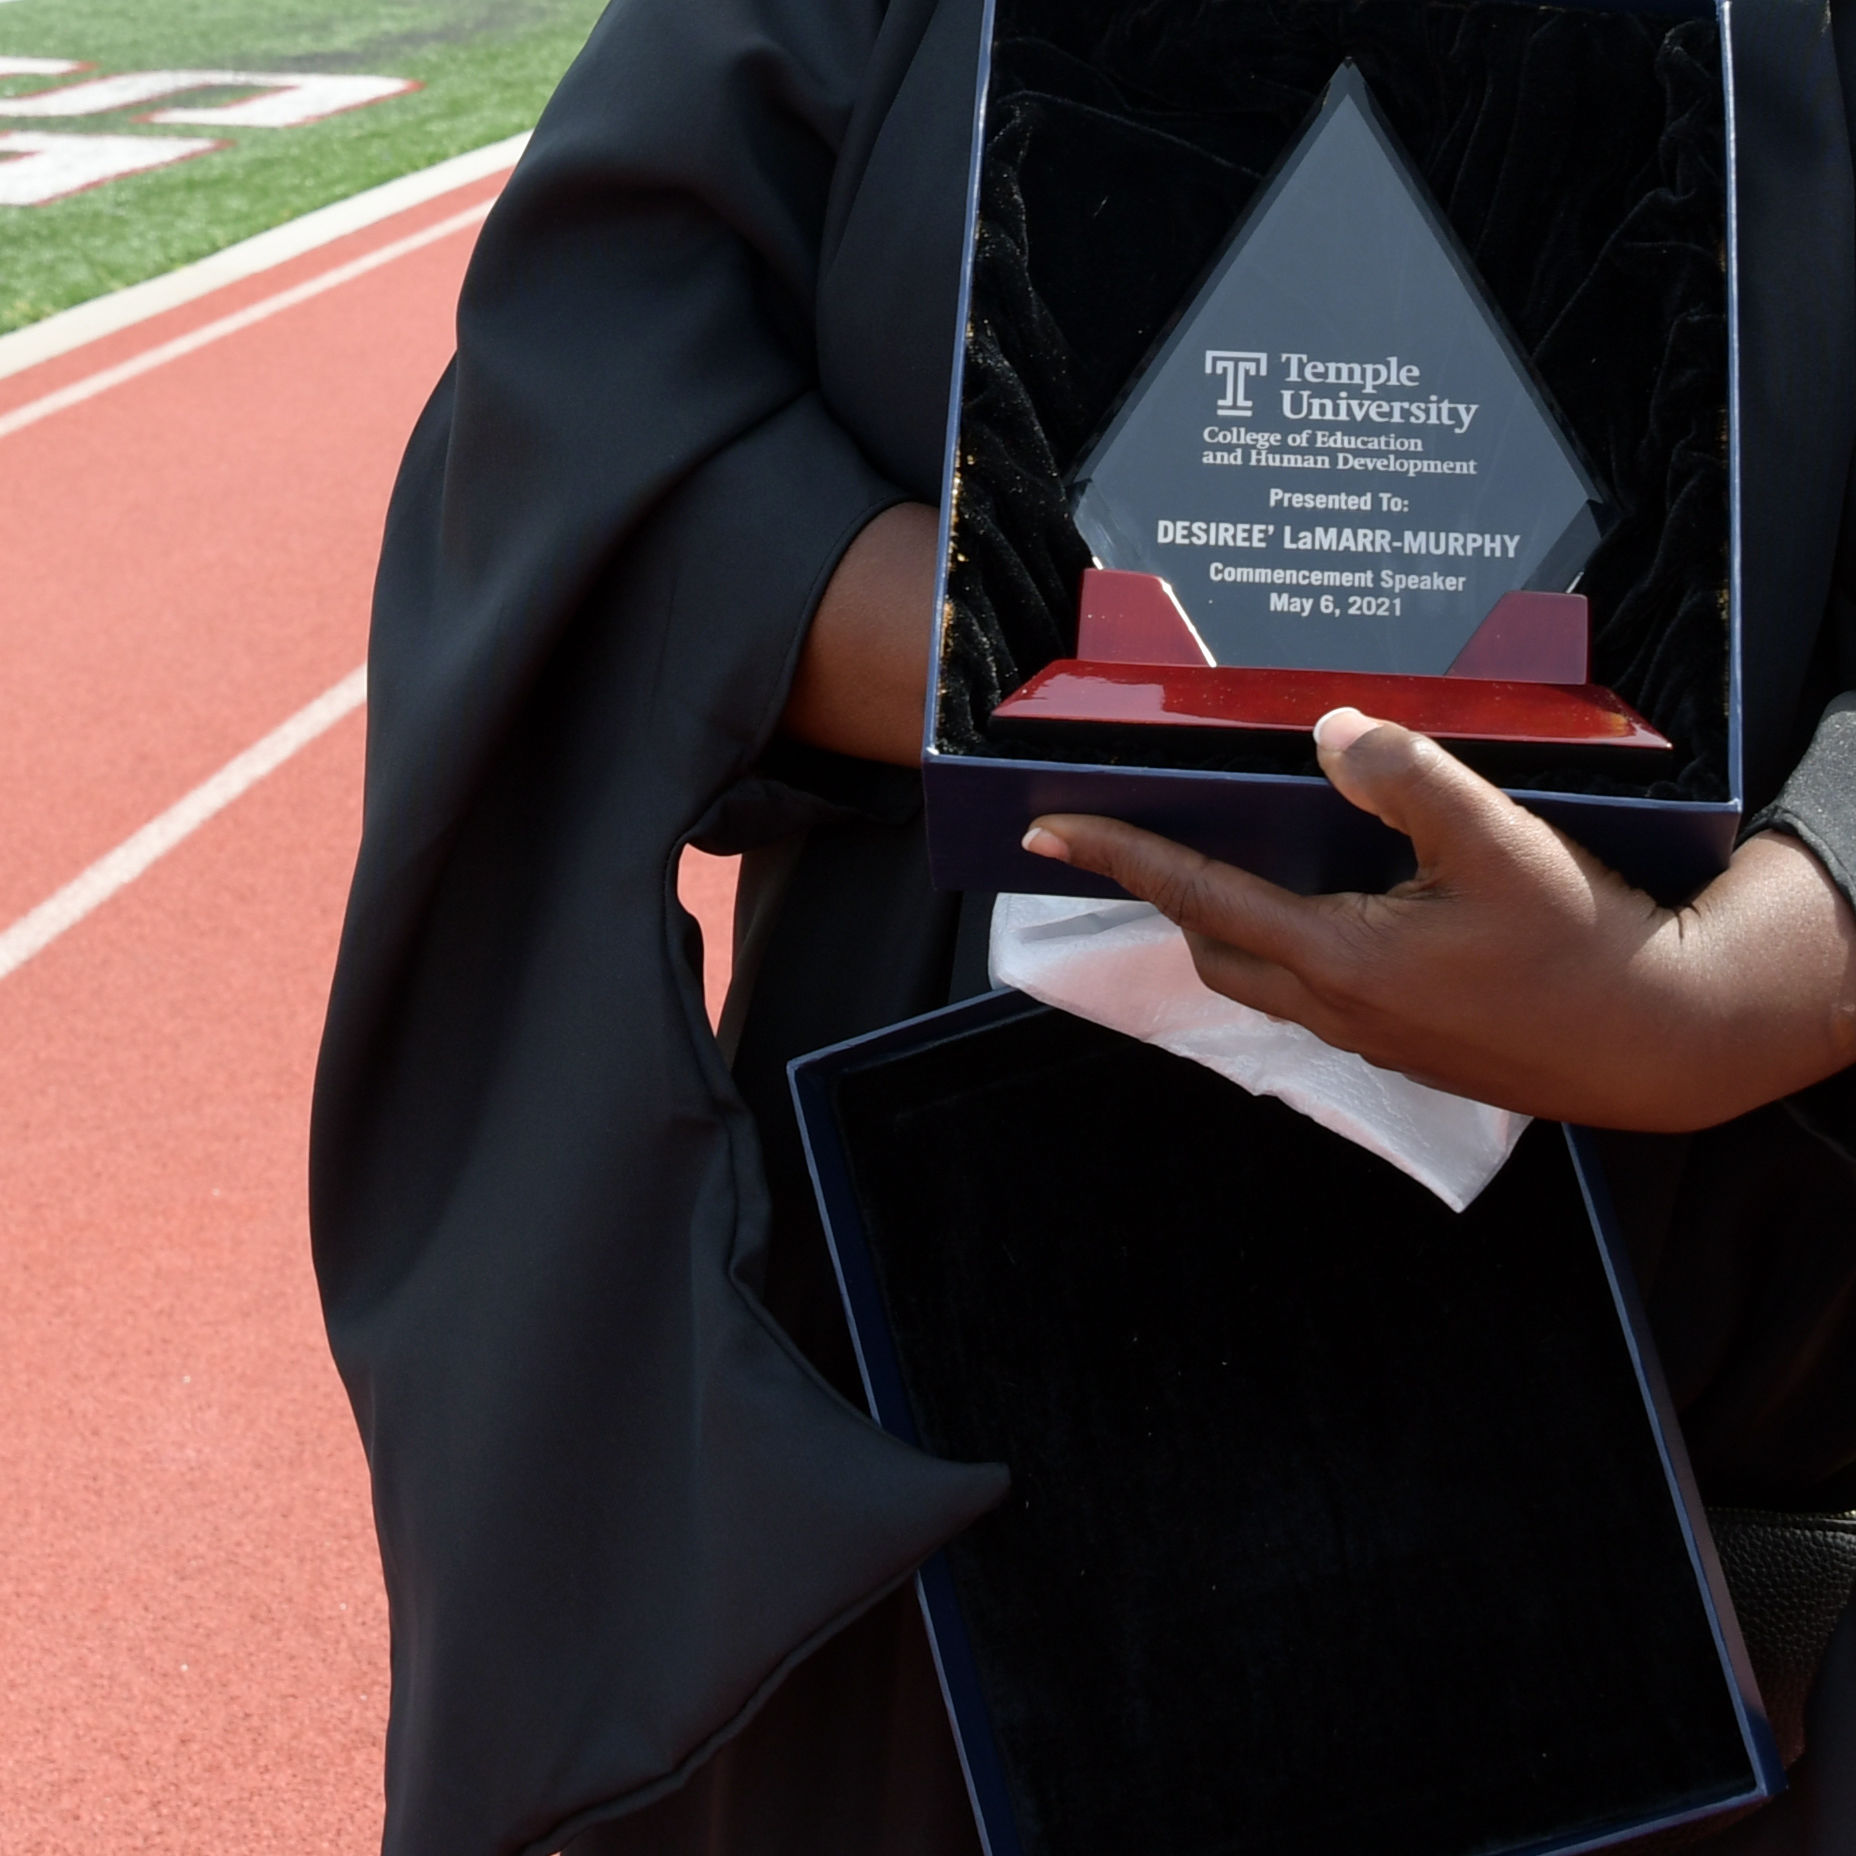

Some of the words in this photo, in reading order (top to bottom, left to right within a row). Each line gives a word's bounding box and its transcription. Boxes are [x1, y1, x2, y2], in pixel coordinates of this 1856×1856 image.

[1280, 353, 1421, 394] Temple
[1280, 389, 1480, 434] University
[1202, 426, 1282, 450] College
[1286, 429, 1313, 447] of
[1314, 430, 1424, 452] Education
[1201, 447, 1243, 466] and
[1248, 449, 1331, 469] Human
[1336, 452, 1478, 477] Development
[1269, 488, 1372, 511] Presented
[1378, 492, 1410, 513] To:
[1156, 520, 1275, 548] DESIREE'
[1283, 526, 1521, 558] LaMARR-MURPHY
[1209, 561, 1374, 588] Commencement
[1380, 569, 1467, 593] Speaker
[1269, 593, 1314, 617] May
[1319, 595, 1341, 618] 6,
[1347, 596, 1402, 618] 2021
